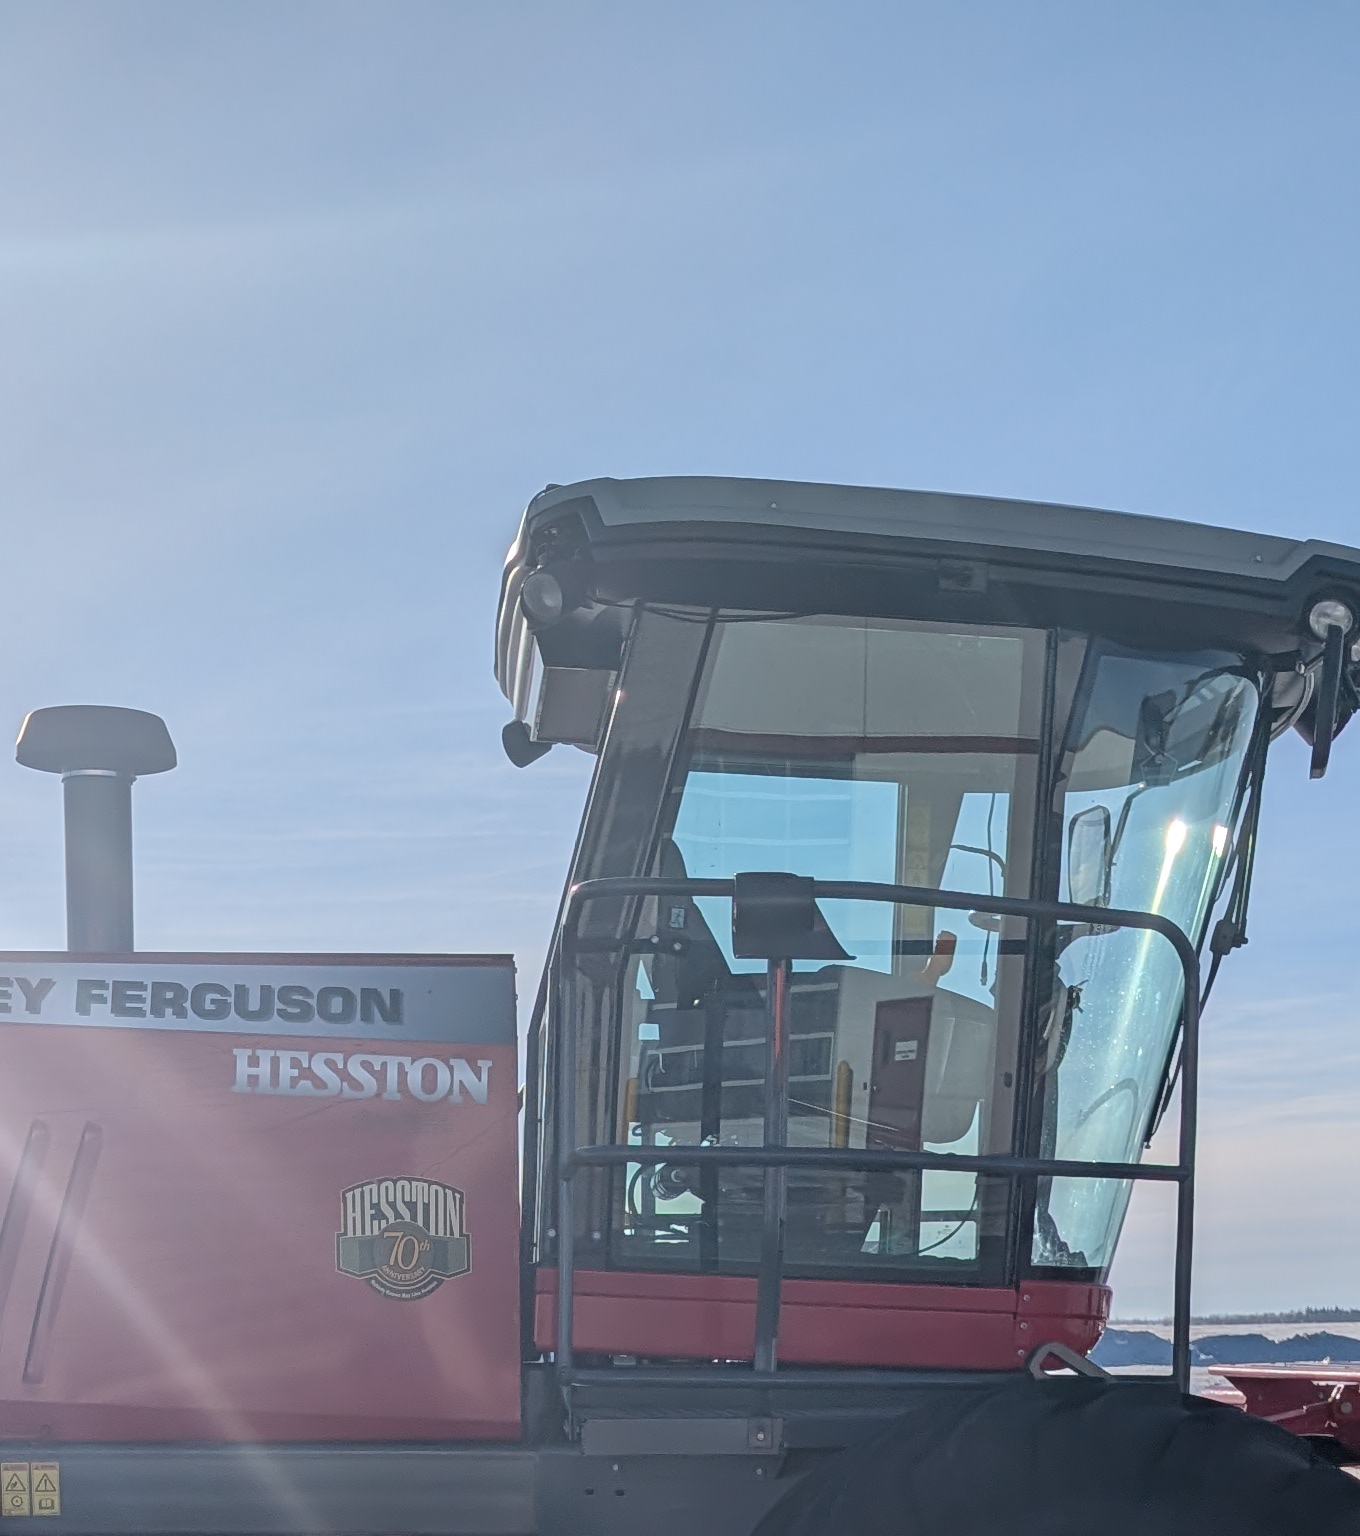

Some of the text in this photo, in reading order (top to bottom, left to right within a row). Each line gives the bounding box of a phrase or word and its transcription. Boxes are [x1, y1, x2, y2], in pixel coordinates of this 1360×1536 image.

[75, 979, 405, 1026] FERGUSON
[231, 1047, 493, 1104] HESSTON
[345, 1179, 461, 1239] HESSTON
[381, 1264, 426, 1281] ANNIVERSARY
[383, 1231, 431, 1270] 70th
